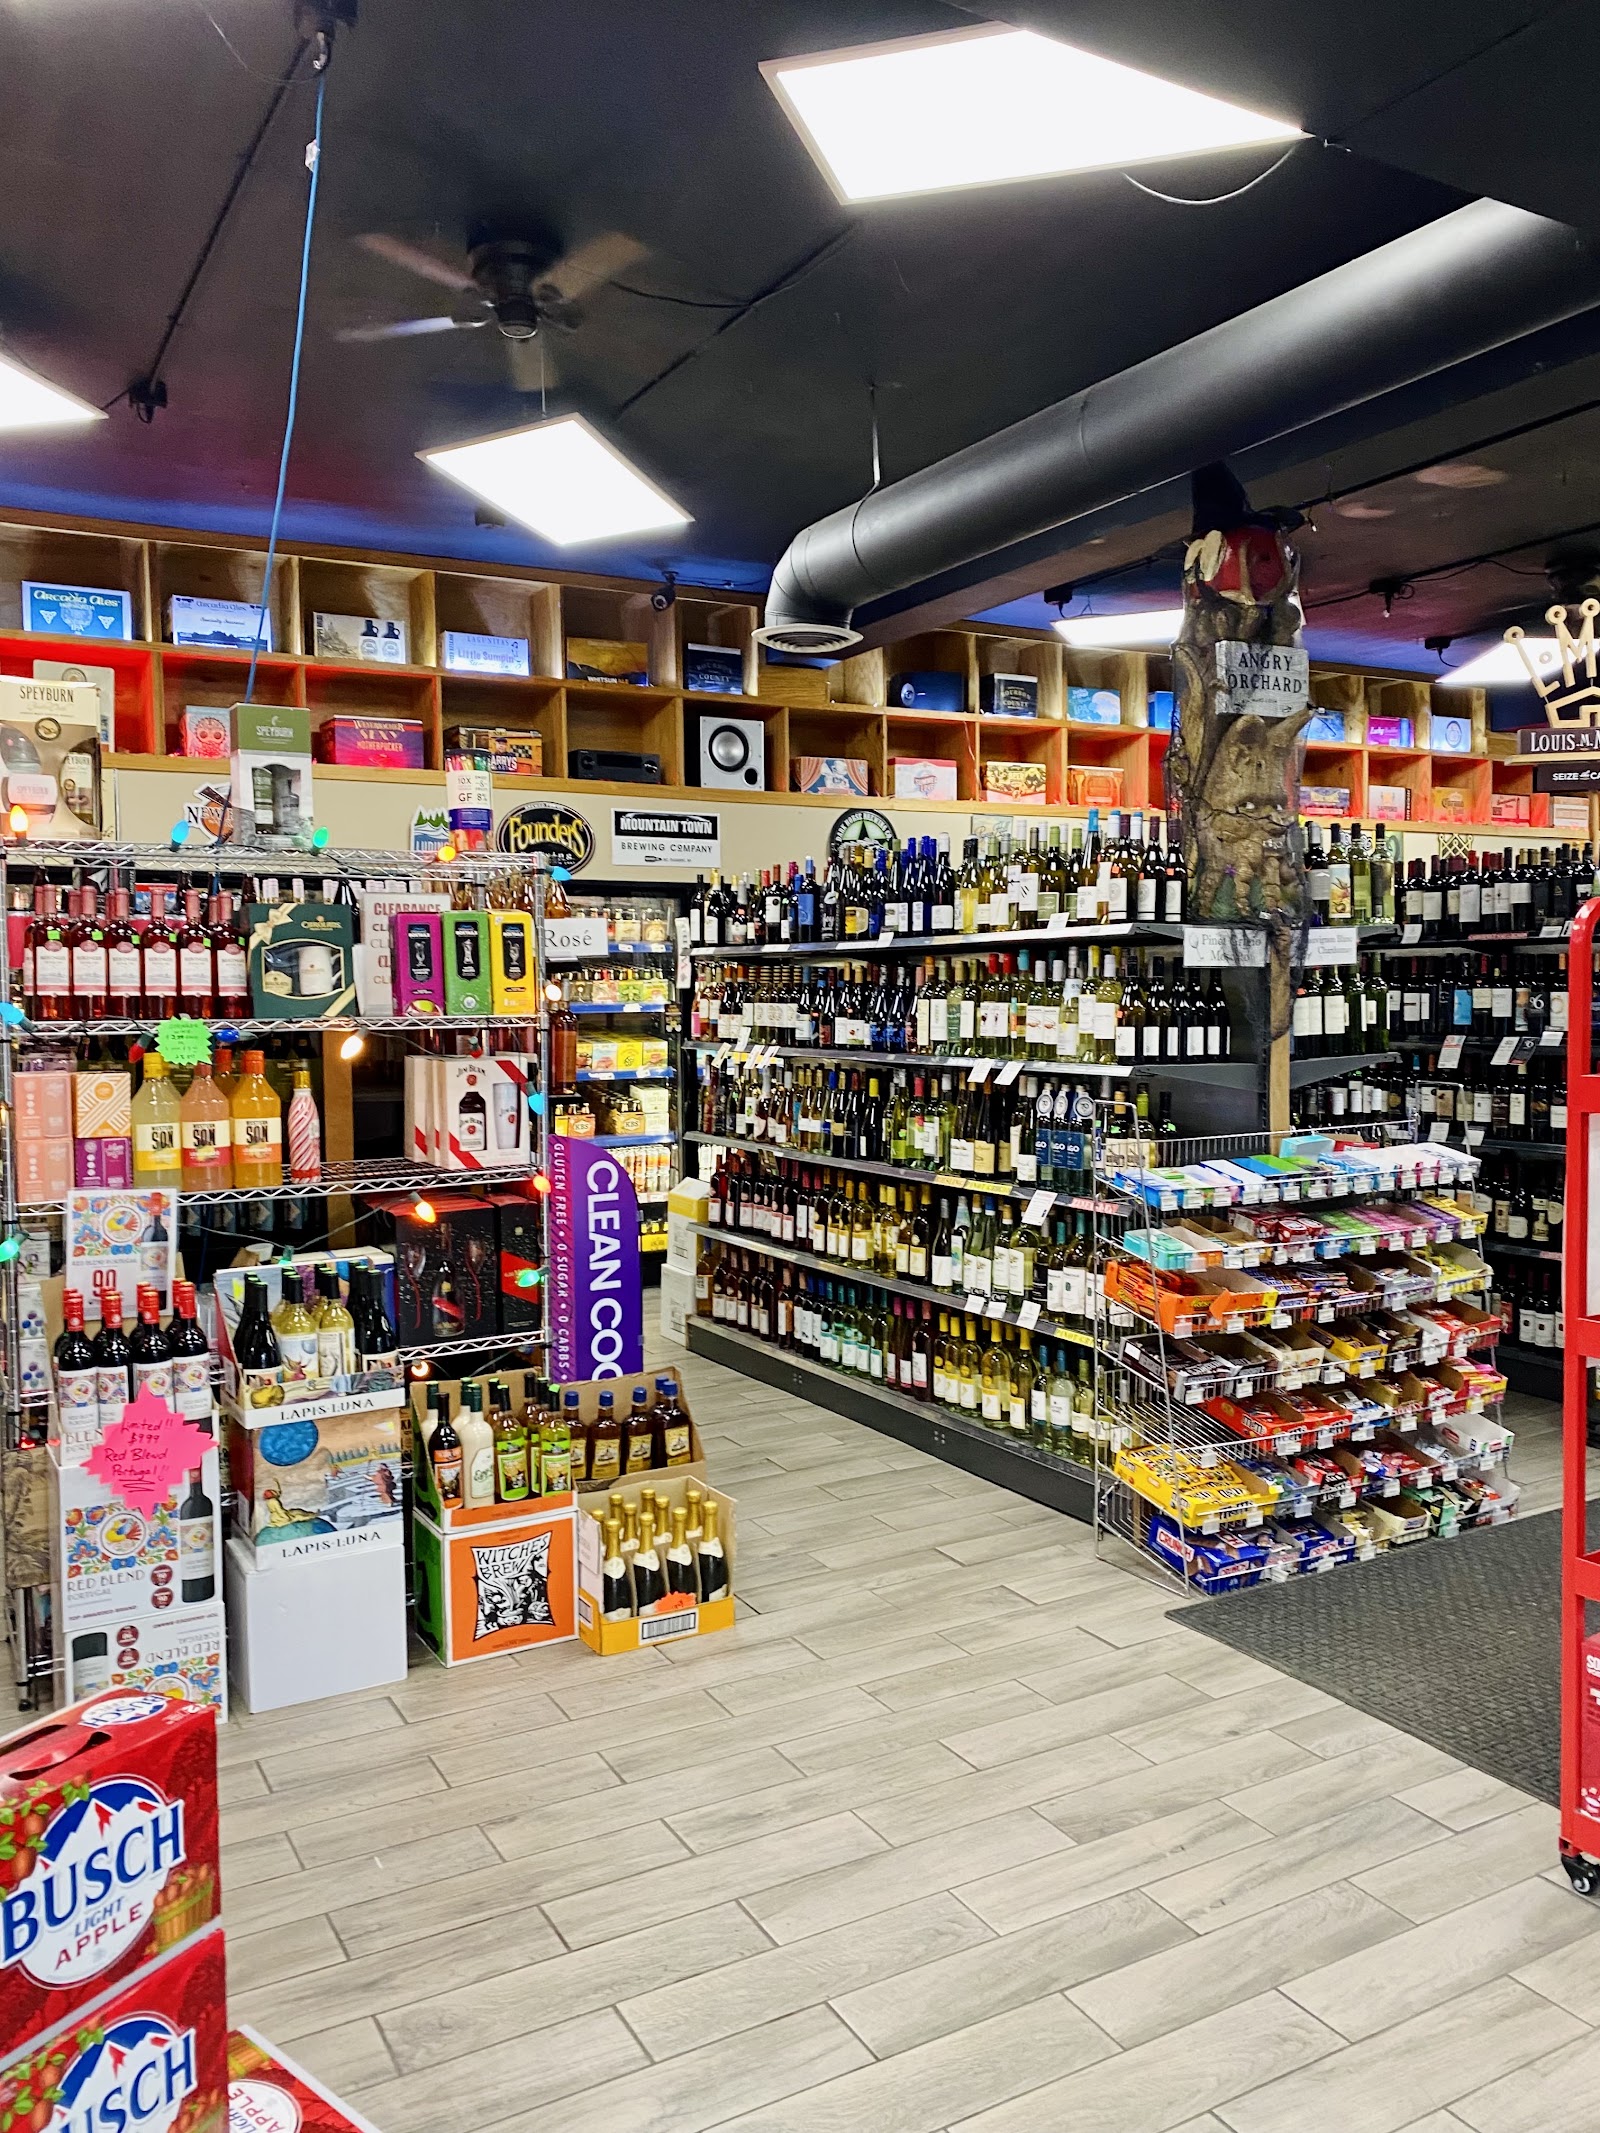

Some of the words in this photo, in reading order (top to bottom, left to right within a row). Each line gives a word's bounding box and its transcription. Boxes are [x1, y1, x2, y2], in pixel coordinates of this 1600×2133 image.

[457, 648, 481, 661] Little
[1238, 652, 1293, 672] ANGRY
[19, 685, 74, 703] SPEYBURN
[1227, 673, 1303, 694] ORCHARD
[256, 725, 294, 739] SPEYBURN
[1530, 732, 1576, 752] LOUIS
[66, 756, 90, 766] EYBURN
[1552, 772, 1579, 781] SEIZE
[458, 792, 473, 803] GF
[619, 814, 679, 833] MOUNTAIN
[680, 818, 713, 835] TOWN
[508, 813, 586, 859] Founders
[621, 841, 665, 852] BREWING
[669, 843, 713, 854] COMPANY
[151, 1130, 175, 1150] SON
[193, 1128, 216, 1147] SON
[246, 1126, 269, 1144] SON
[553, 1142, 566, 1190] GLUTEN
[555, 1192, 568, 1225] FREE
[586, 1160, 622, 1292] CLEAN
[557, 1256, 569, 1298] SUGAR
[558, 1326, 570, 1369] CARBS
[104, 1447, 127, 1461] Red
[130, 1447, 169, 1461] Blend
[476, 1535, 549, 1565] WITCHES
[480, 1559, 526, 1580] BREW
[67, 1577, 97, 1593] RED
[100, 1569, 146, 1587] BLEND
[82, 1694, 167, 1728] BUSCH
[1, 1801, 185, 1963] BUSCH
[73, 1896, 124, 1938] LIGHT
[54, 1902, 144, 1971] APPLE
[58, 2029, 198, 2133] USCH
[228, 2088, 287, 2133] APPLE
[229, 2106, 257, 2133] LIGH
